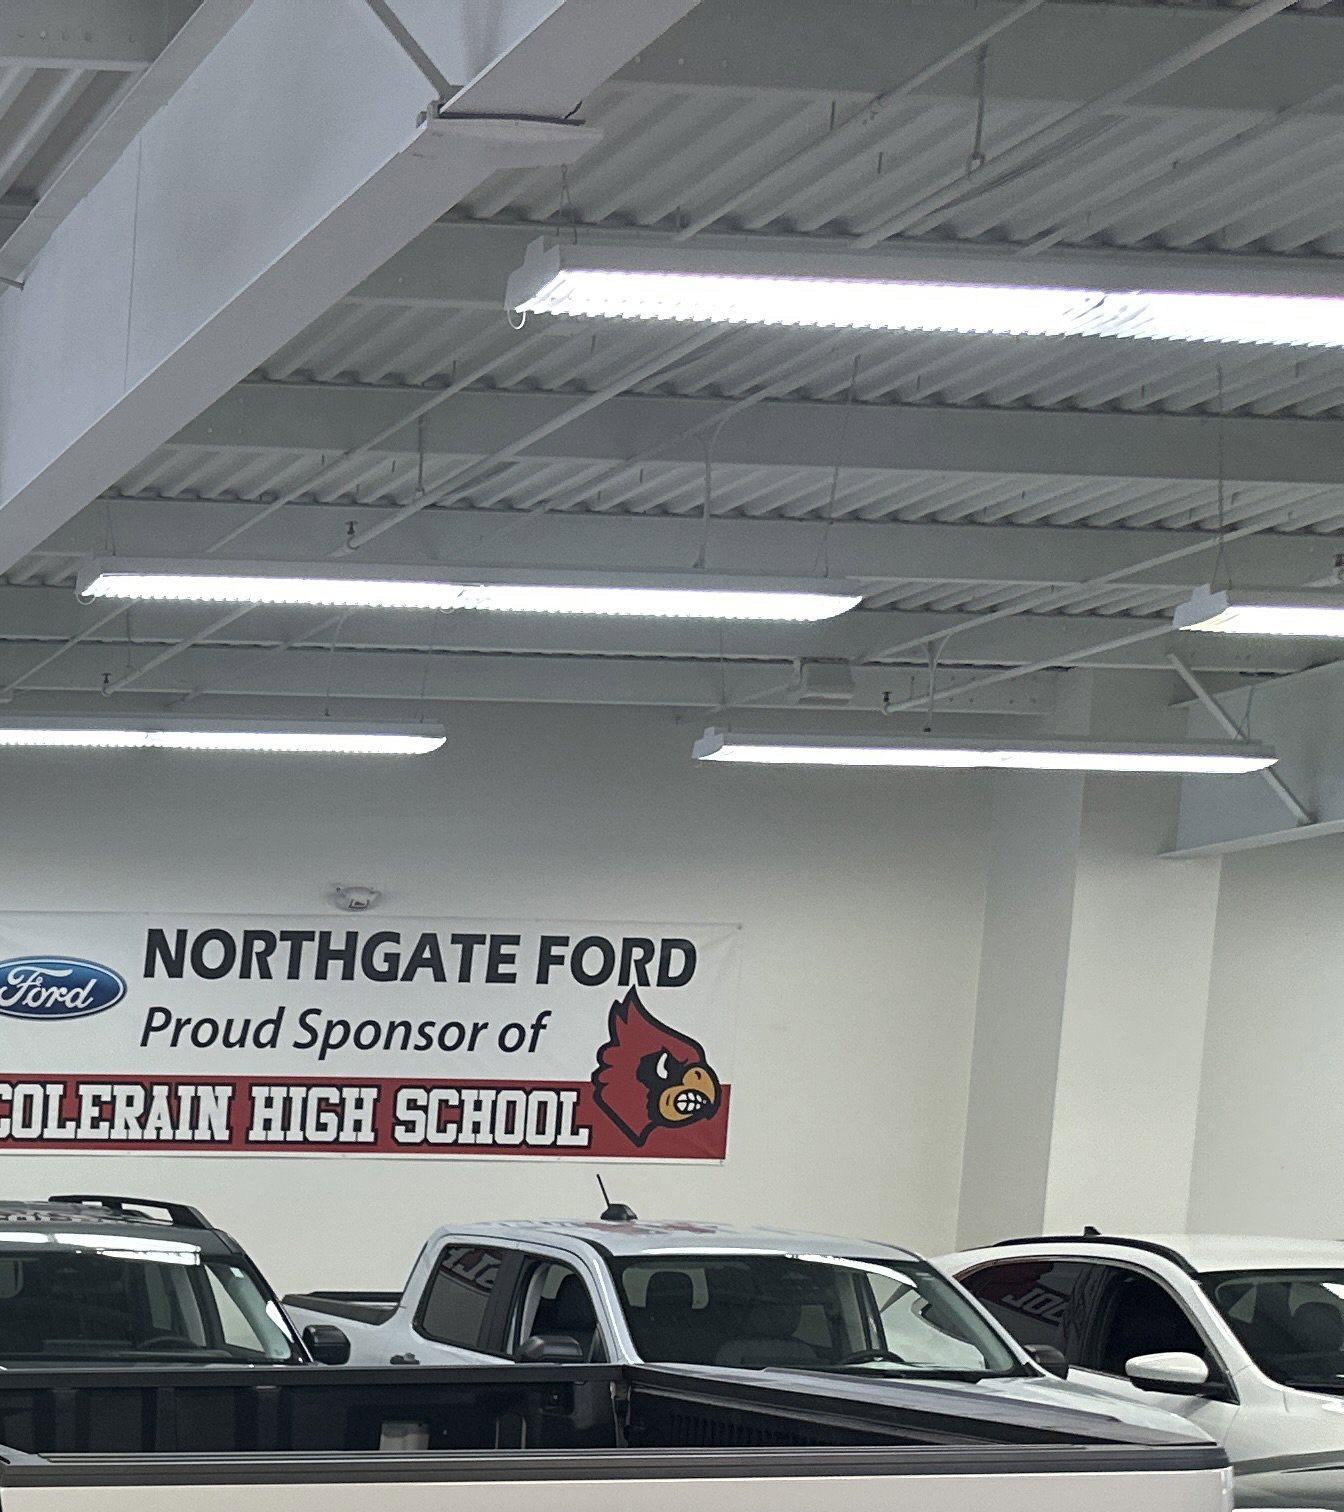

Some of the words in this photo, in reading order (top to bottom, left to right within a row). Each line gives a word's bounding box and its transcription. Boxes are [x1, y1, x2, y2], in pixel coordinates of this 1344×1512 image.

[143, 928, 521, 984] NORTHGATE
[536, 935, 698, 988] FORD
[140, 1005, 286, 1049] Proud
[292, 1007, 489, 1061] Sponsor
[498, 1010, 552, 1053] of
[246, 1082, 381, 1146] HIGH
[392, 1085, 592, 1149] SCHOOL
